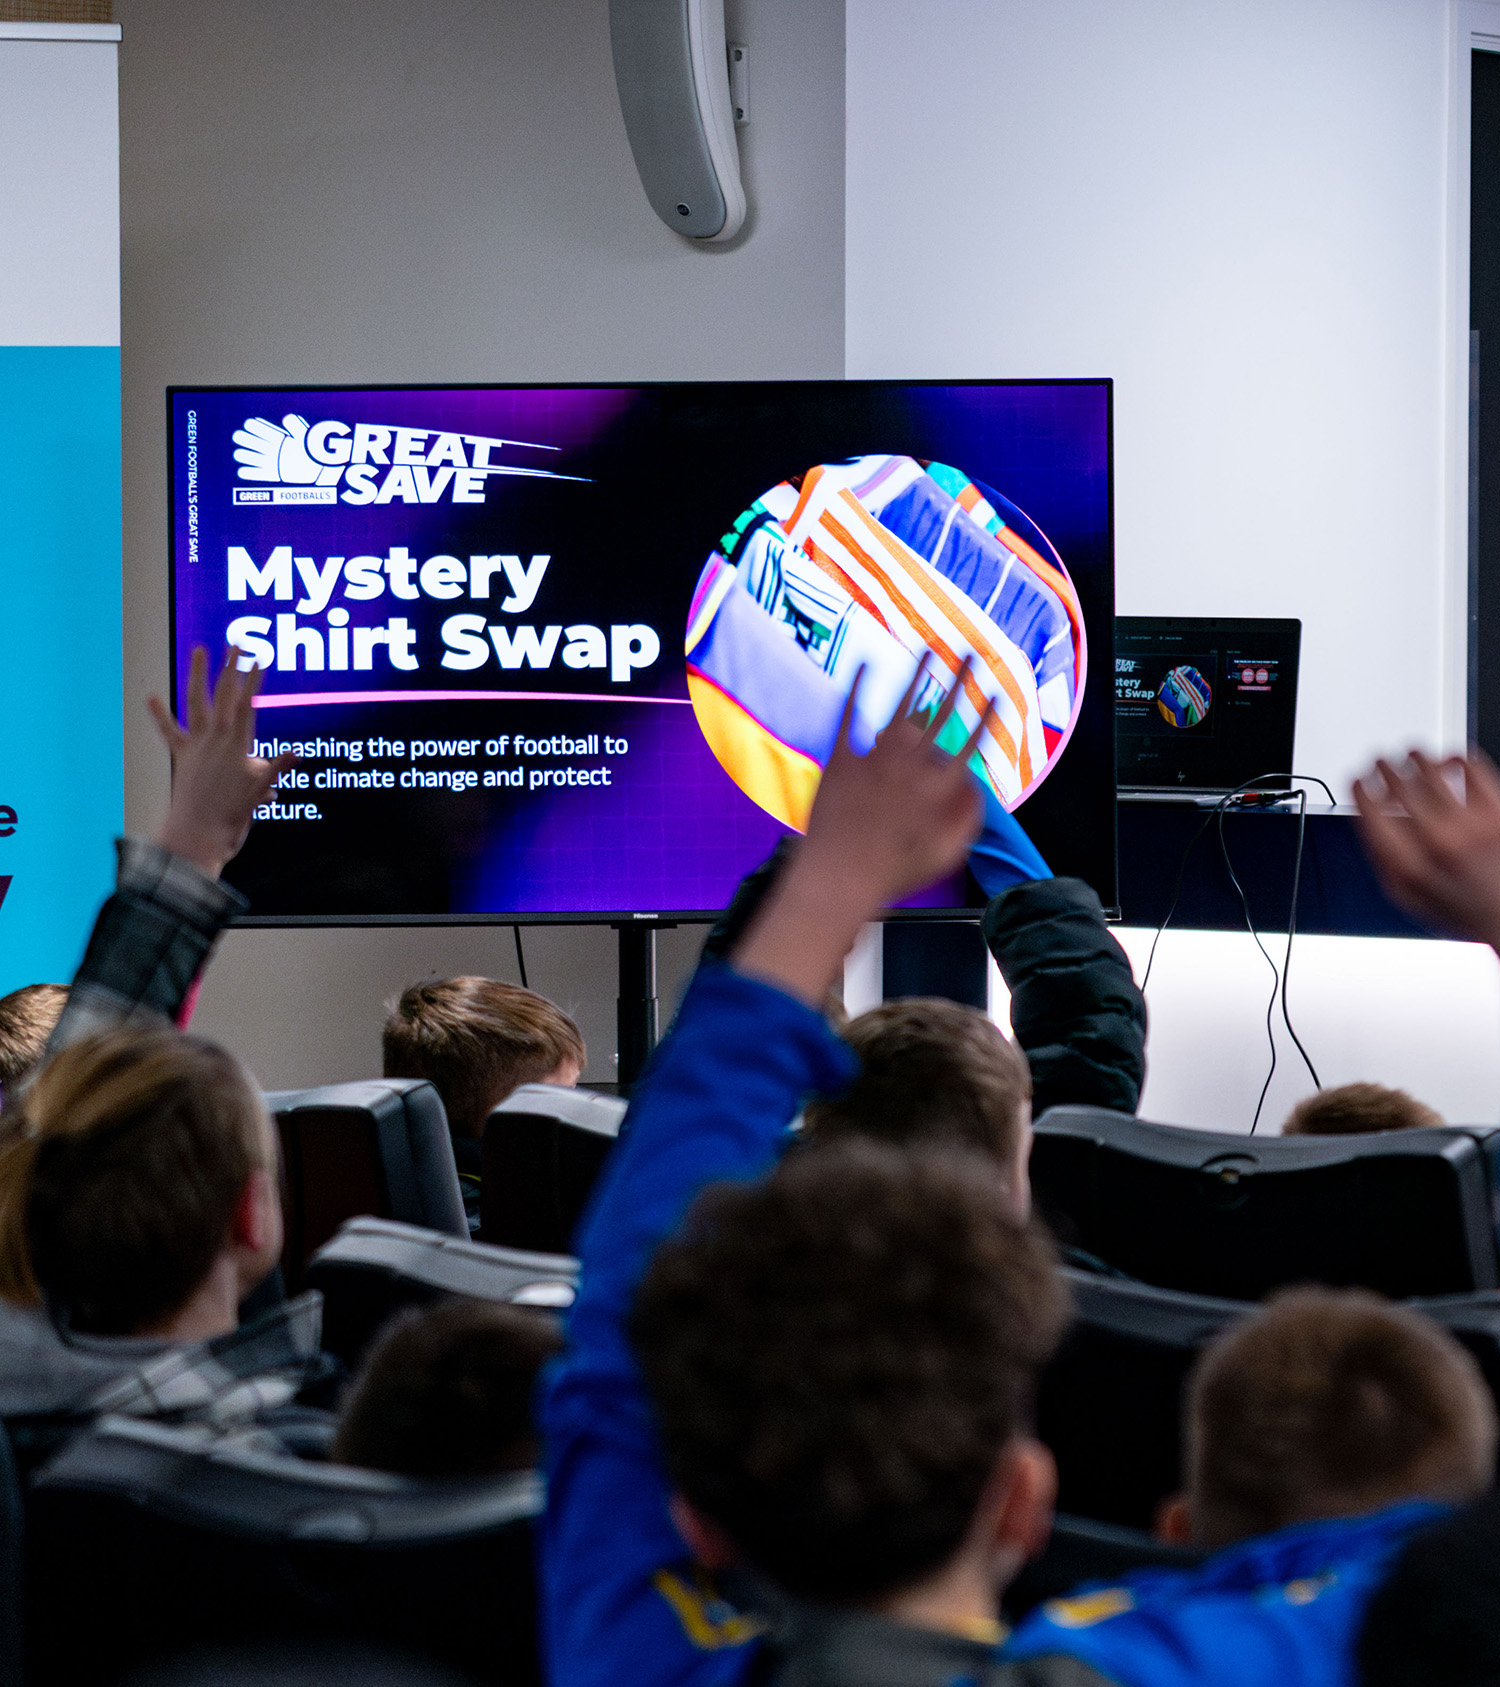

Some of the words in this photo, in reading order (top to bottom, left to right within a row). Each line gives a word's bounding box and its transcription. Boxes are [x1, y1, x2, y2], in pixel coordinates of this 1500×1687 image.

[187, 410, 197, 444] GREEN
[306, 420, 502, 468] GREAT
[188, 445, 198, 503] FOOTBALL'S
[340, 464, 488, 505] SAVE
[239, 491, 270, 502] GREEN
[280, 491, 331, 500] FOOTBALL'S
[188, 504, 199, 536] GREAT
[189, 537, 199, 563] SAVE
[227, 546, 551, 615] Mystery
[225, 607, 419, 673] Shirt
[440, 613, 660, 682] Swap
[1125, 688, 1155, 700] Swap
[367, 737, 405, 757] the
[411, 740, 481, 761] power
[485, 736, 509, 755] of
[513, 735, 599, 755] football
[603, 736, 628, 755] to
[270, 769, 309, 788] kle
[314, 768, 395, 788] climate
[400, 767, 478, 792] change
[484, 767, 524, 787] and
[529, 766, 612, 790] protect
